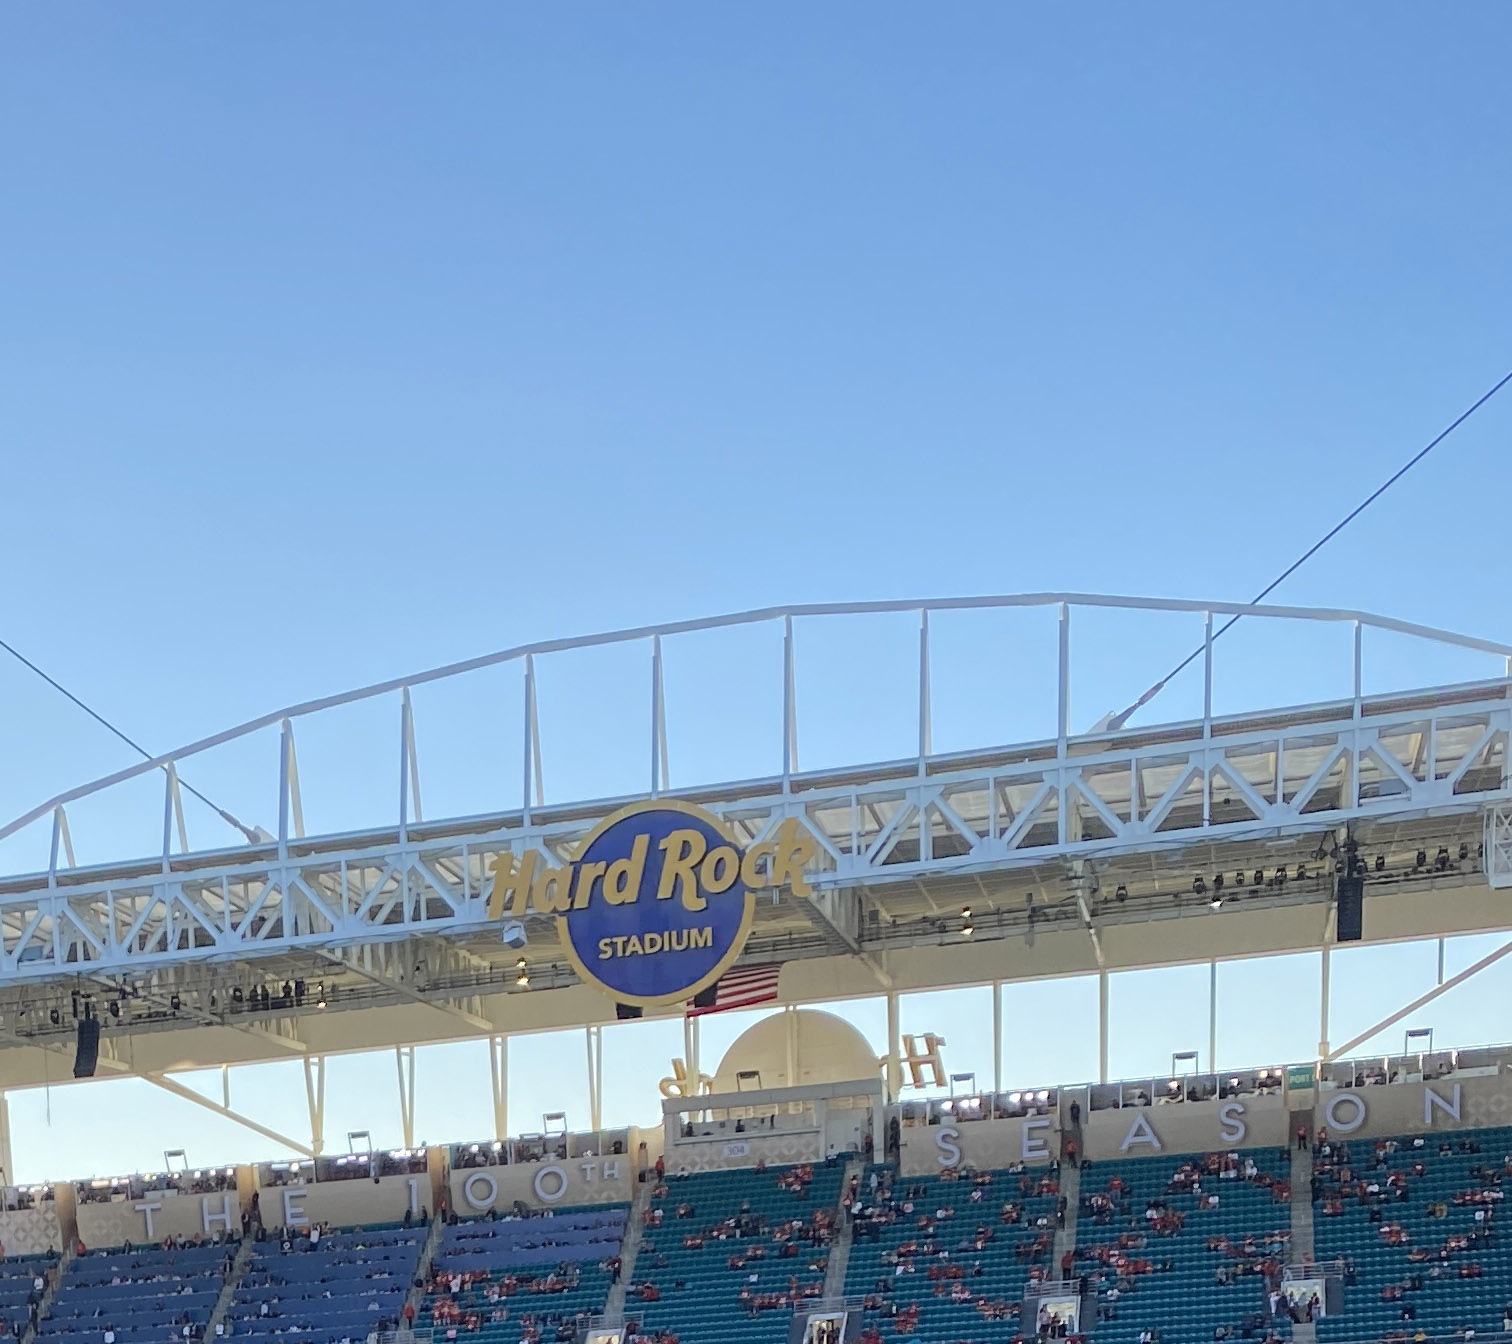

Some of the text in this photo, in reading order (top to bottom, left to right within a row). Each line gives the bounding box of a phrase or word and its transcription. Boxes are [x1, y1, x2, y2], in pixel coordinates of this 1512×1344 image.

[488, 816, 814, 920] Hard Rock
[598, 926, 713, 960] STADIUM
[134, 1083, 1461, 1238] THE 100TH SEASON
